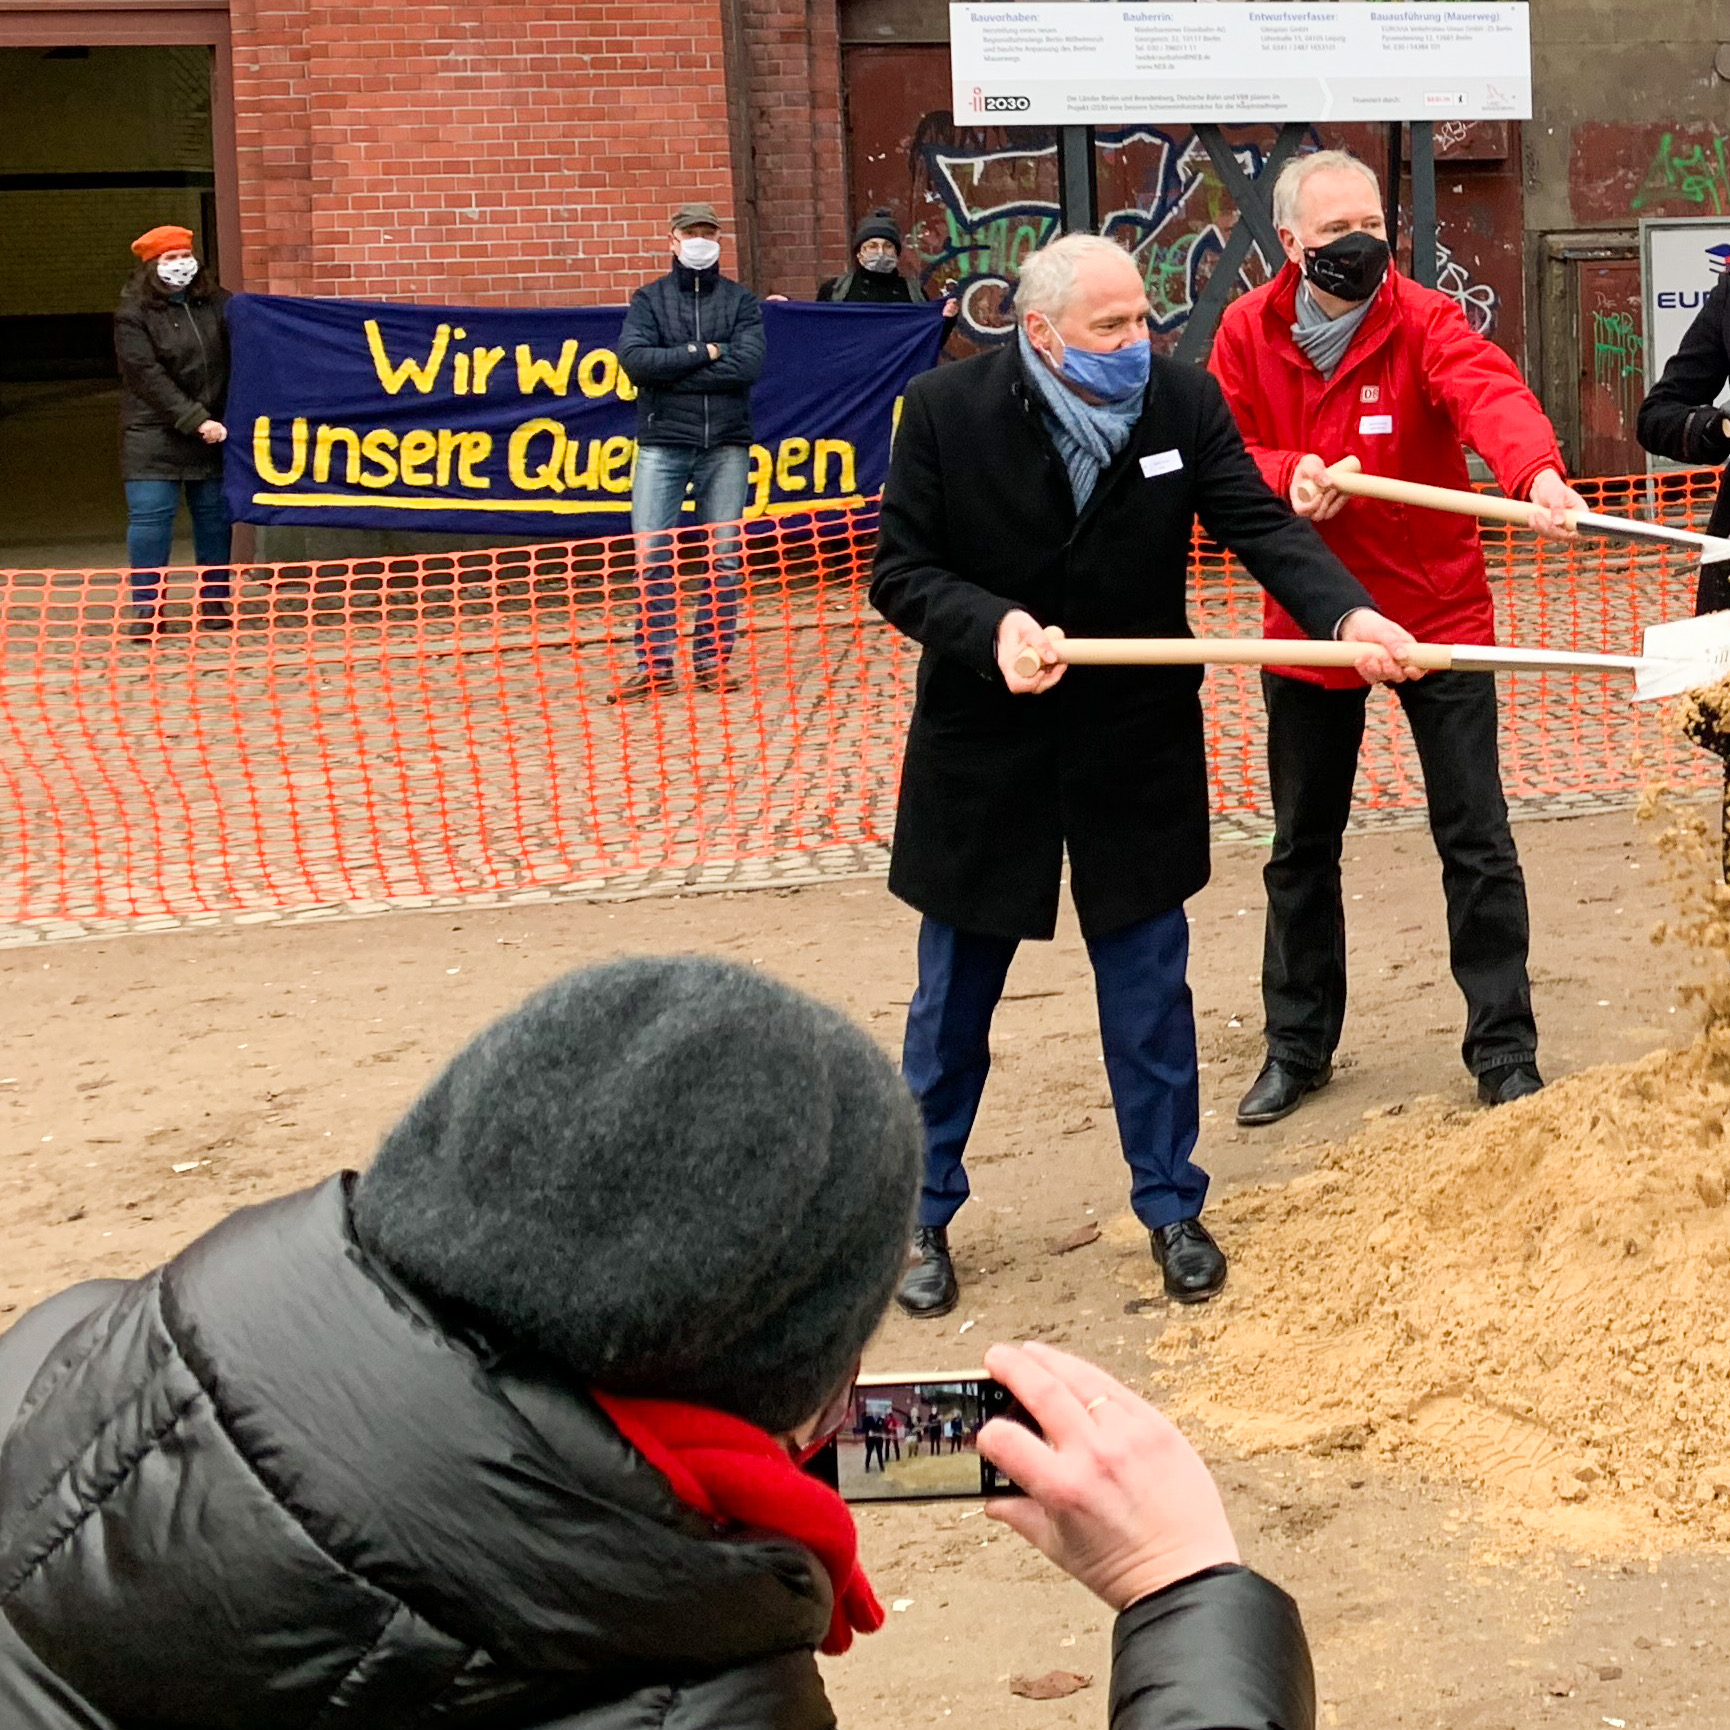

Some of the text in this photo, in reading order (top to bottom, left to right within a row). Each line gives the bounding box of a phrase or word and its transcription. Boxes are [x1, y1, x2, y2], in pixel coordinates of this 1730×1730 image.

[970, 12, 1039, 22] Bauvorhaben:
[1123, 12, 1173, 22] Bauherrin:
[1249, 11, 1338, 21] Entwurfsverfasser:
[1370, 12, 1441, 22] Bauausführung
[363, 318, 506, 396] Wir
[253, 415, 493, 489] Unsere
